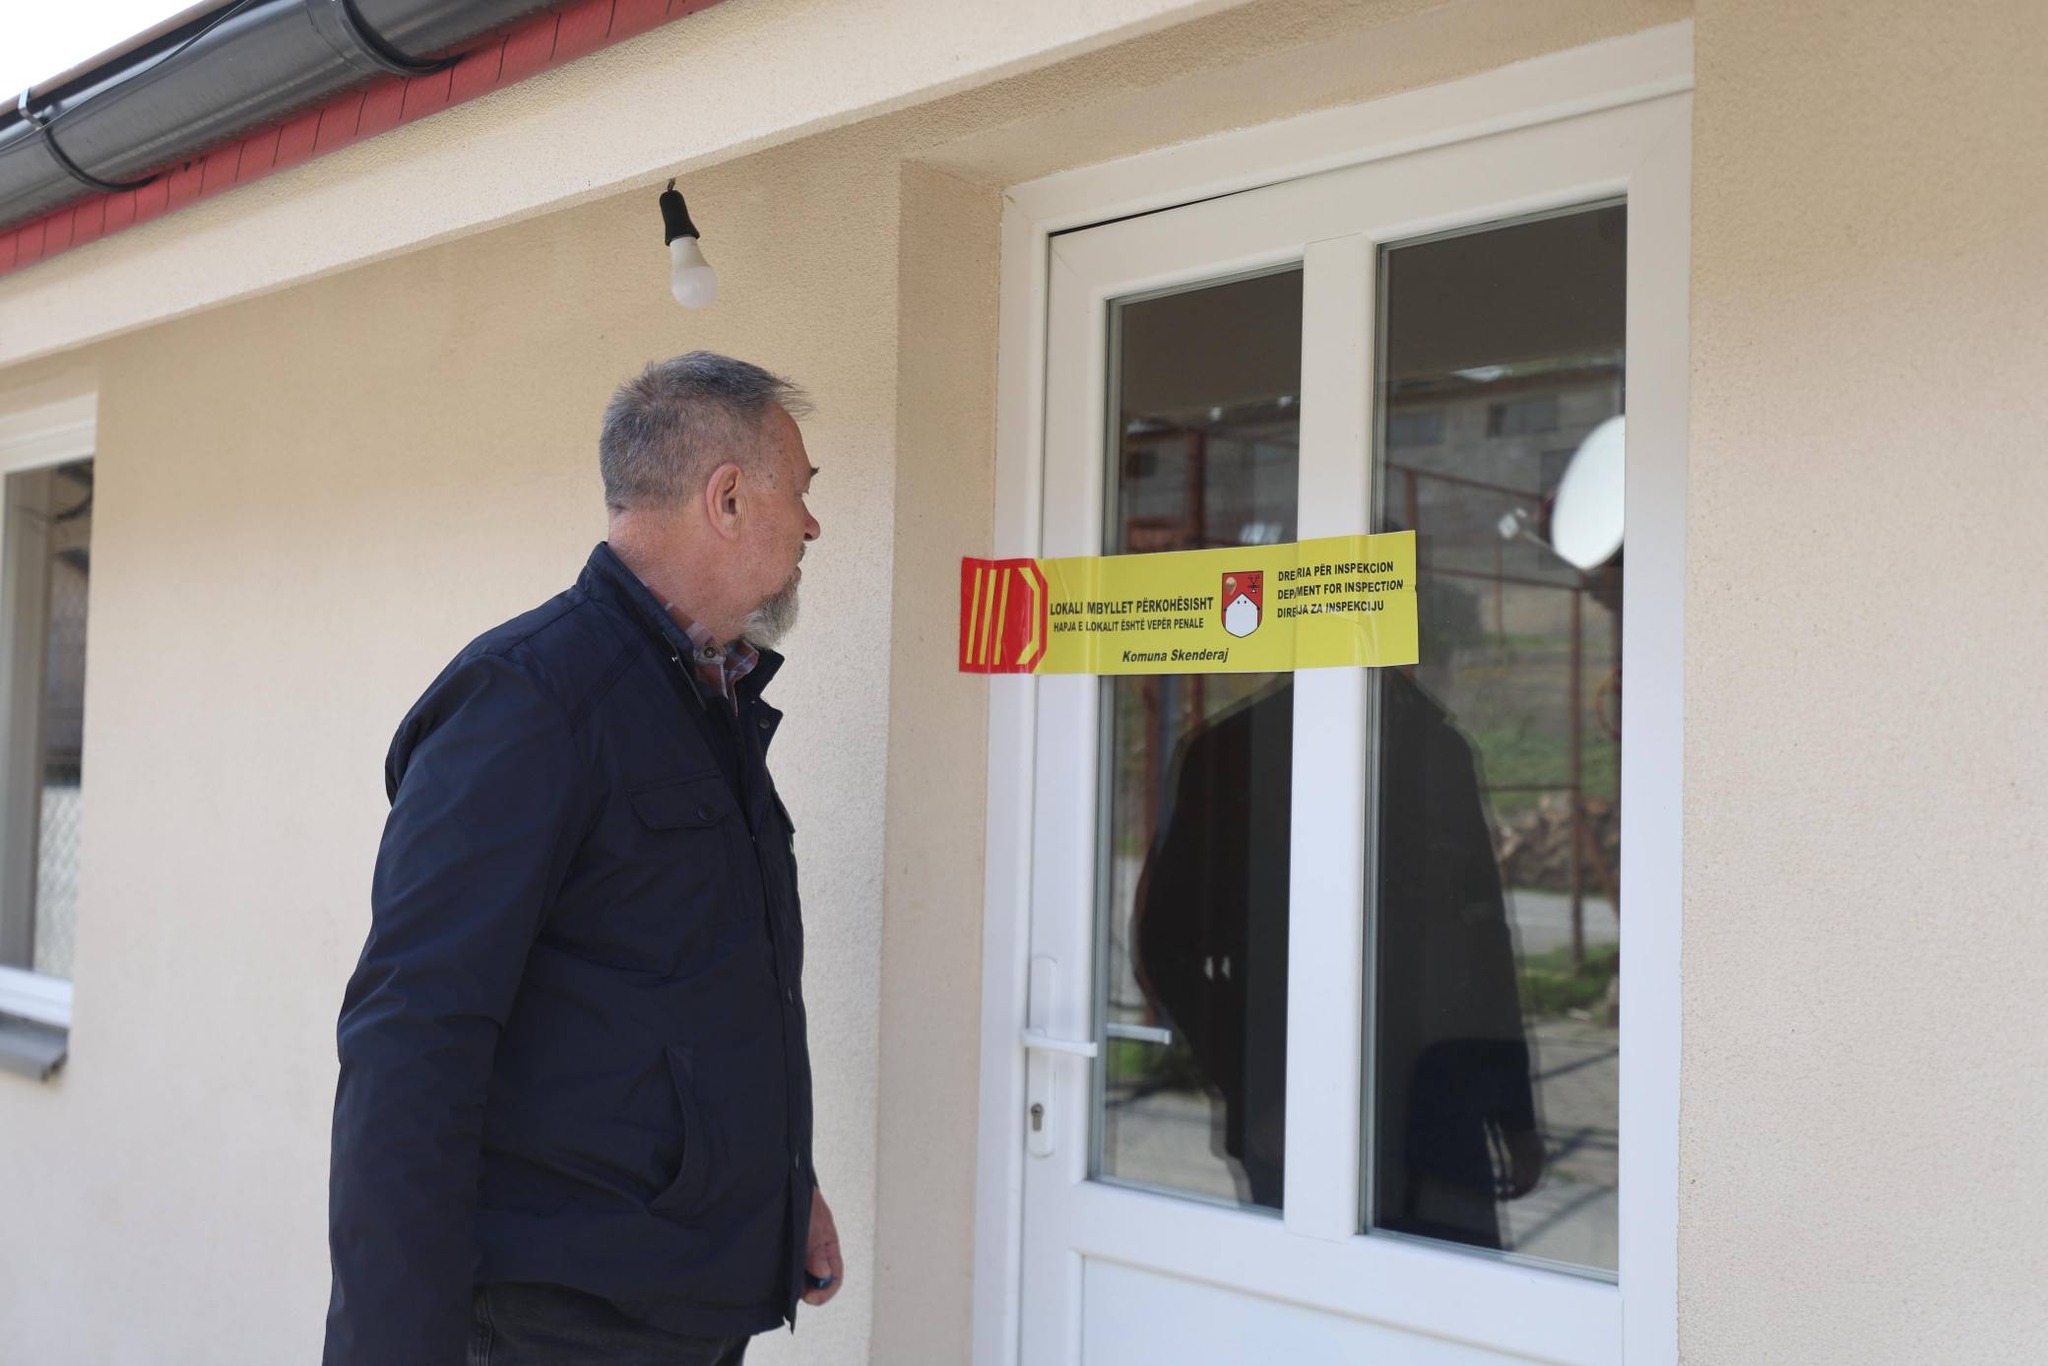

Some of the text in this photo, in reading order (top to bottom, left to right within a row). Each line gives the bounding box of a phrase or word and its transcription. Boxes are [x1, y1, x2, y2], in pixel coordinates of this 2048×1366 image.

[1314, 563, 1332, 577] PËR
[1335, 561, 1394, 575] INSPEKCION
[1324, 583, 1342, 595] FOR
[1344, 580, 1403, 593] INSPECTION
[1050, 596, 1214, 615] LOKALI MBYLLET PËRKOHËSISHT
[1311, 603, 1323, 614] ZA
[1325, 600, 1384, 613] INSPEKCIJU
[1053, 622, 1076, 633] HAPJA
[1078, 621, 1083, 631] E
[1086, 621, 1119, 632] LOKALIT
[1174, 618, 1204, 629] PENALE
[1122, 648, 1229, 663] Komuna Skenderaj
